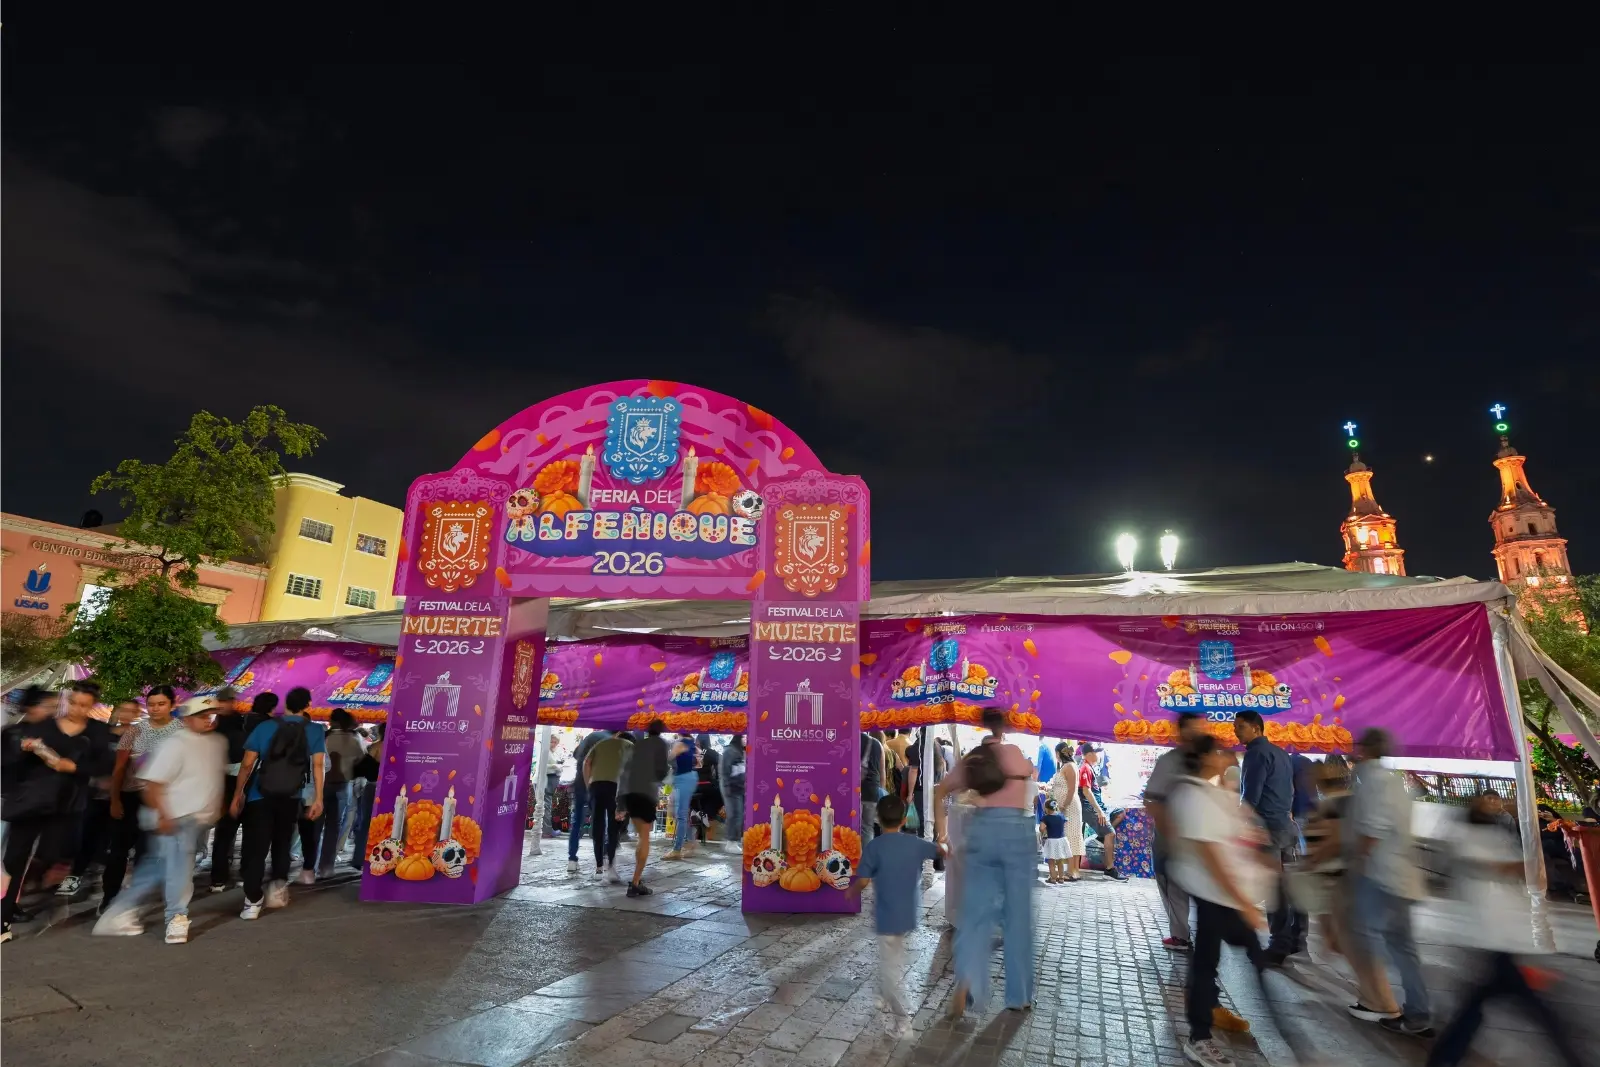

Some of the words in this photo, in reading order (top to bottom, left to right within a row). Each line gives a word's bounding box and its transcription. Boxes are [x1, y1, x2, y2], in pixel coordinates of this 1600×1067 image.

[591, 489, 640, 504] FERIA
[644, 489, 677, 504] DEL
[505, 507, 757, 546] ALFEÑIQUE
[32, 540, 82, 558] CENTRO
[592, 551, 664, 575] 2026
[15, 598, 49, 610] USAG
[418, 601, 463, 611] FESTIVAL
[464, 602, 478, 612] DE
[478, 602, 491, 612] LA
[768, 607, 814, 617] FESTIVAL
[815, 607, 829, 617] DE
[830, 608, 843, 618] LA
[403, 616, 502, 636] MUERTE
[755, 622, 856, 643] MUERTE
[426, 640, 470, 655] 2026
[782, 647, 826, 662] 2026
[891, 678, 995, 699] ALFEÑIQUE
[1199, 683, 1225, 691] FERIA
[1226, 683, 1244, 691] DEL
[925, 694, 955, 706] 2026
[1159, 691, 1292, 709] ALFEÑIQUE
[697, 704, 724, 713] 2026
